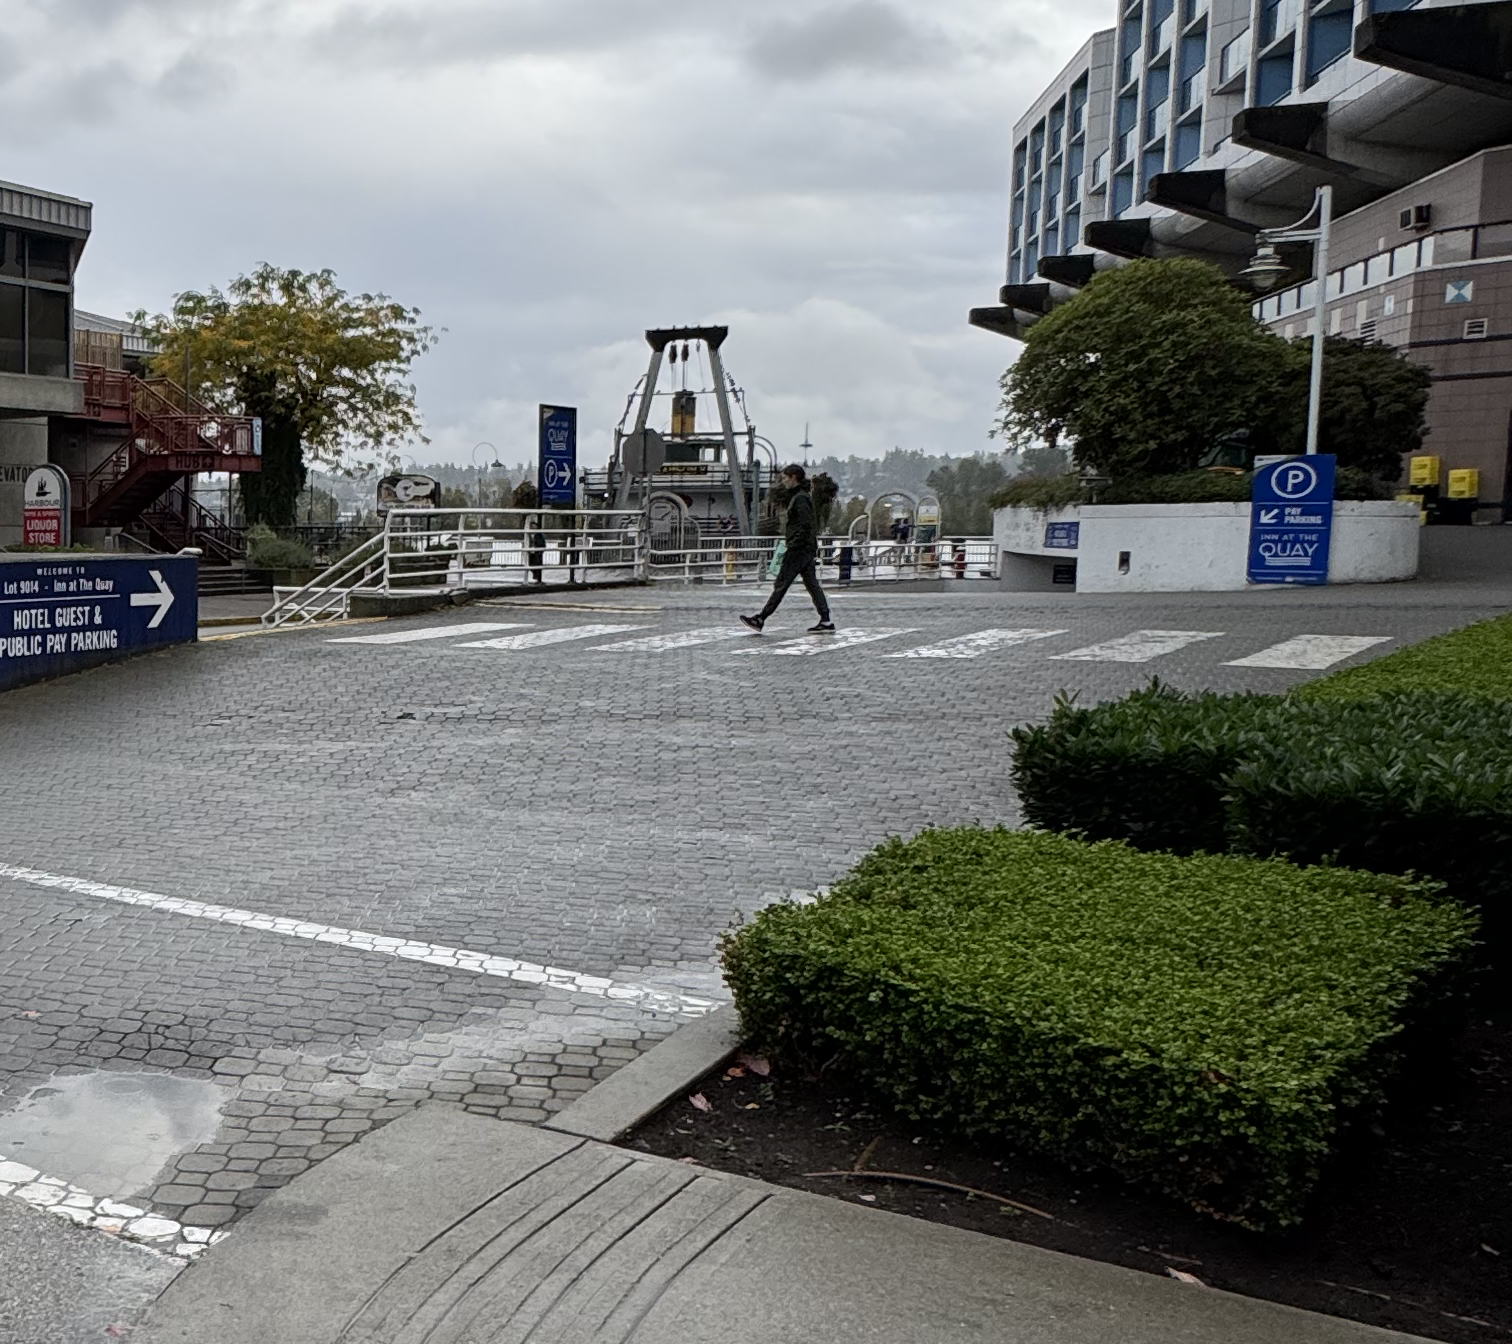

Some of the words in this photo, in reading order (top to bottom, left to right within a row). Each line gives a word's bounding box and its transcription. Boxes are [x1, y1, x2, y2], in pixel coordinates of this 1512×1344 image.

[1286, 470, 1305, 492] P
[1284, 507, 1302, 515] PAY
[26, 519, 59, 531] LIQUOR
[1284, 515, 1323, 524] PARKING
[28, 532, 56, 544] STORE
[1299, 533, 1319, 541] THE
[1259, 542, 1320, 557] QUAY
[36, 566, 73, 576] WELCOME
[76, 566, 85, 575] TO
[4, 581, 17, 595] Lot
[19, 580, 39, 594] 9014
[53, 579, 67, 593] Inn
[68, 579, 77, 592] at
[79, 578, 93, 592] The
[95, 577, 114, 592] Quay
[13, 608, 51, 631] HOTEL
[54, 606, 90, 628] GUEST
[93, 605, 103, 625] &
[46, 633, 68, 654] PAY
[70, 629, 118, 652] PARKING
